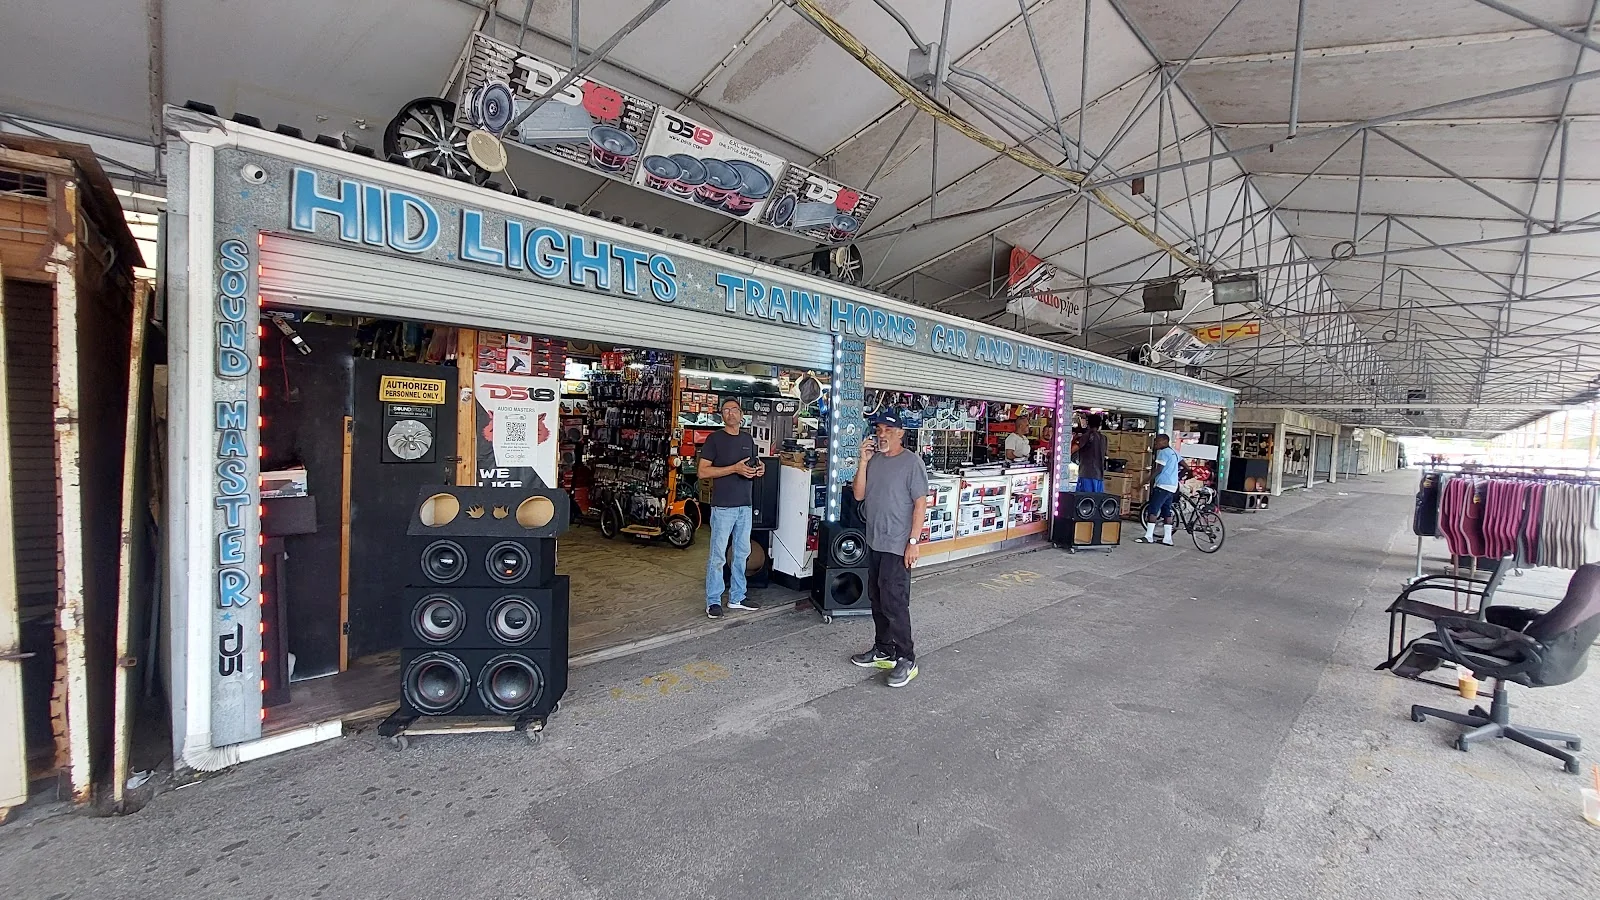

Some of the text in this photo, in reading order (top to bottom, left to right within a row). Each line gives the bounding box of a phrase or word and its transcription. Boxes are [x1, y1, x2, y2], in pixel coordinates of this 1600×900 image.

[664, 114, 714, 146] DS18
[806, 176, 860, 212] DS18
[290, 167, 441, 255] HID
[459, 209, 679, 304] LIGHTS
[715, 272, 822, 329] TRAIN
[830, 298, 917, 347] HORNS
[931, 324, 969, 358] CAR
[974, 335, 1014, 366] AND
[1017, 344, 1054, 374] HOME
[1057, 353, 1125, 388] ELECTRONICS
[1130, 372, 1147, 393] CAR
[386, 380, 440, 392] AUTHORIZED
[480, 383, 556, 402] DS18
[385, 390, 439, 400] PERSONNEL ONLY
[841, 405, 859, 418] BASS
[214, 238, 252, 609] SOUND MASTER
[840, 434, 858, 447] BASS
[505, 453, 526, 461] Google
[479, 468, 511, 479] WE
